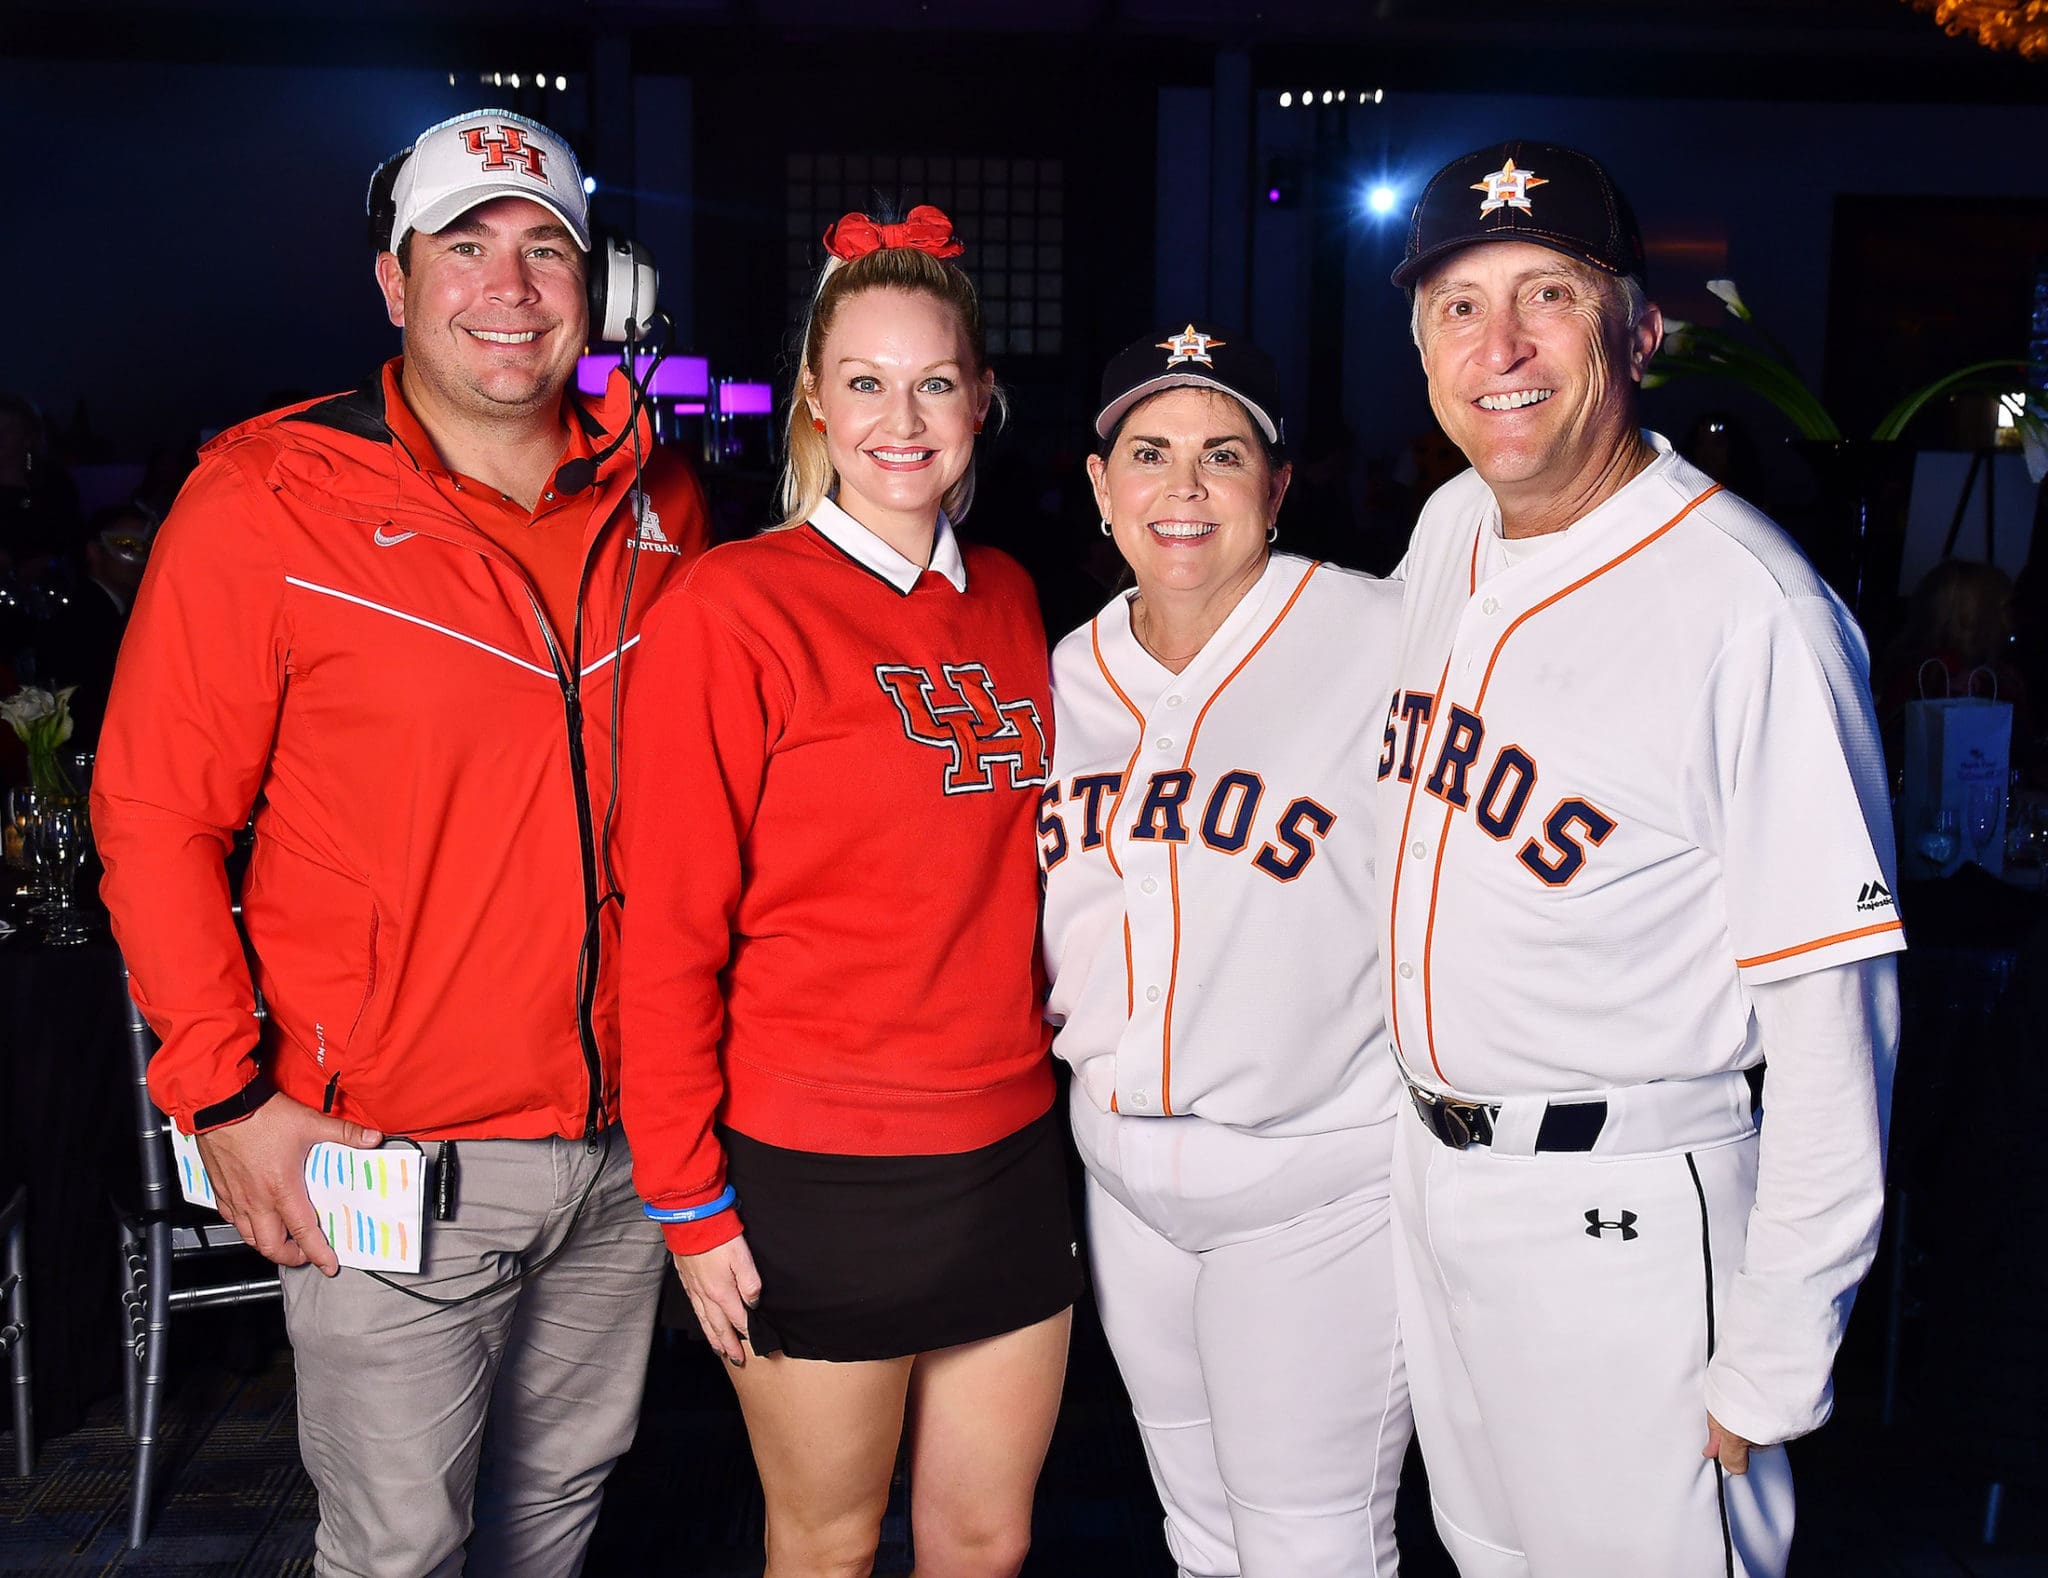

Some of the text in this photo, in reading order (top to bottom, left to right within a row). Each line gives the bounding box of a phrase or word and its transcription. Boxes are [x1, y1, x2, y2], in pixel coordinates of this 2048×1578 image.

[459, 124, 548, 184] UH
[626, 539, 682, 556] FOTBALL
[874, 662, 1049, 796] UH
[1037, 767, 1338, 889] STROS
[1856, 897, 1894, 912] Majestic
[315, 1023, 326, 1067] RM-FIT
